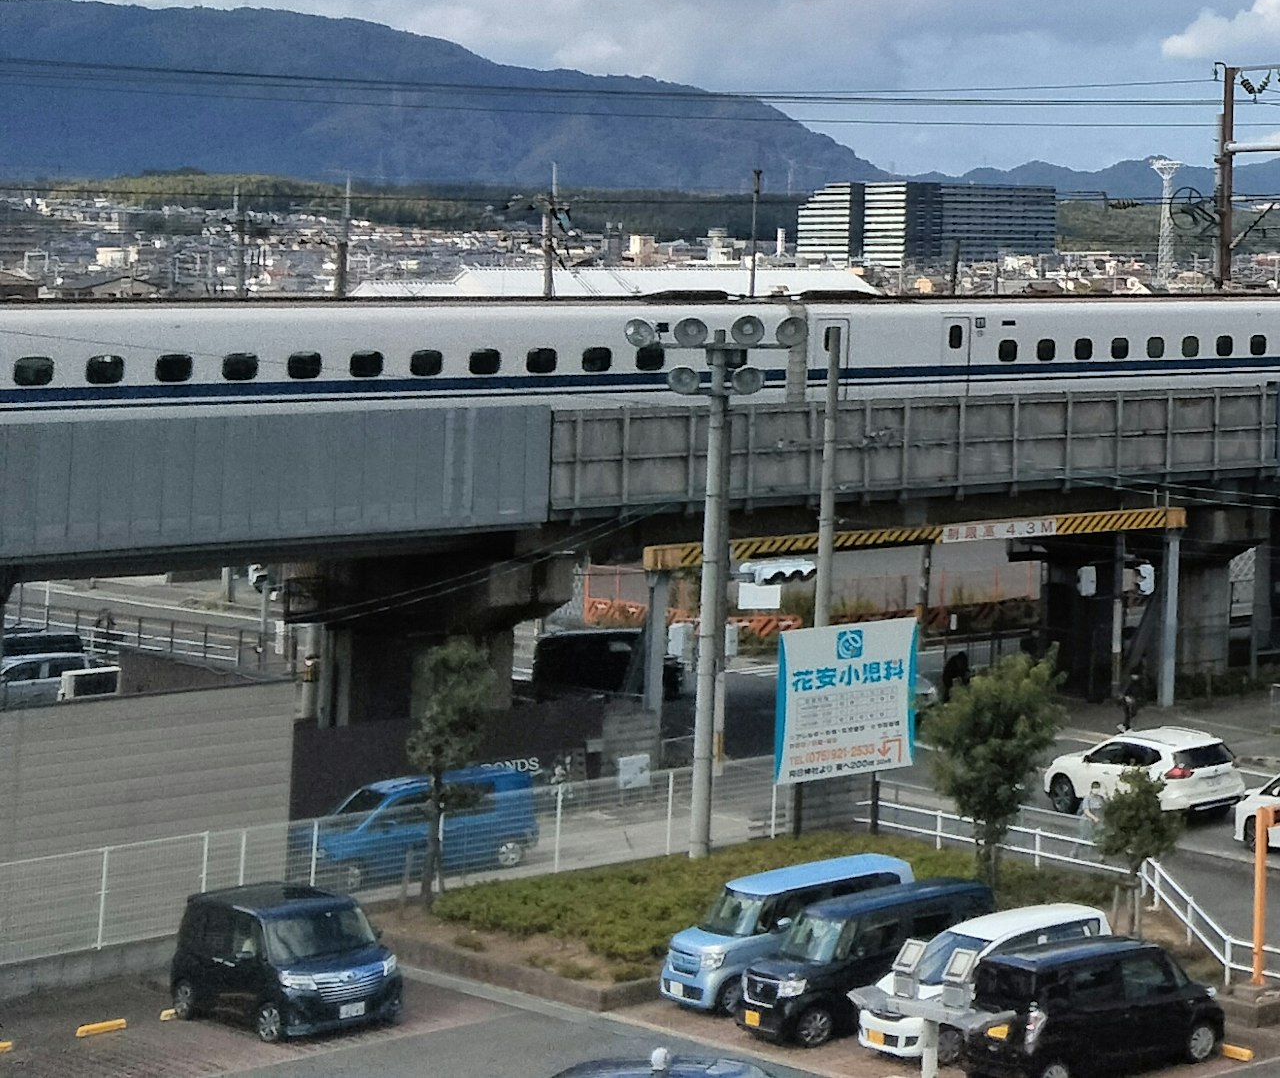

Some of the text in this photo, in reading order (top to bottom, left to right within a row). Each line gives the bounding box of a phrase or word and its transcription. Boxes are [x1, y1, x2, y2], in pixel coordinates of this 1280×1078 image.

[1006, 521, 1053, 536] 4.3M
[792, 659, 905, 692] 花安小児科
